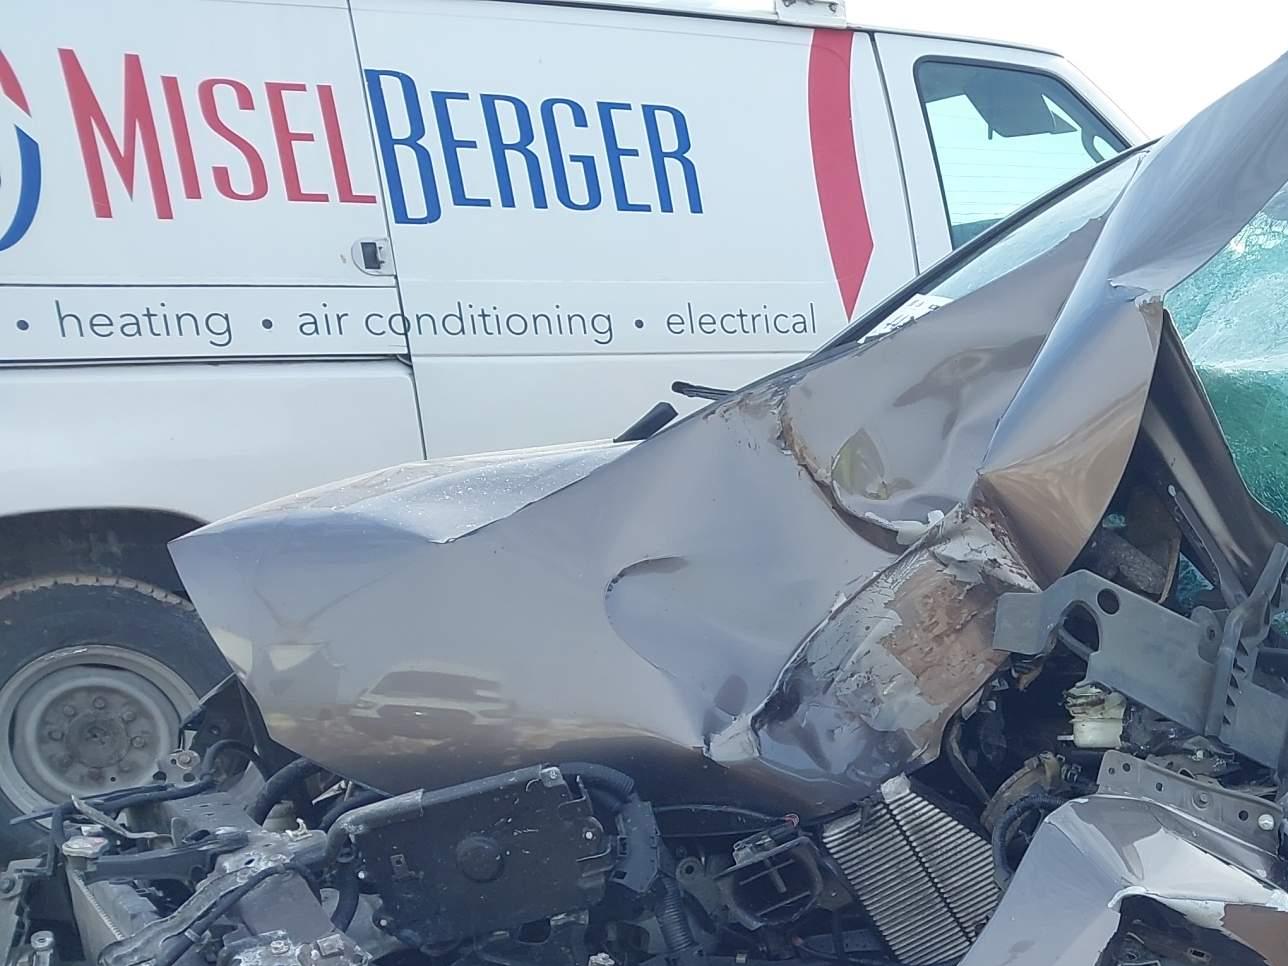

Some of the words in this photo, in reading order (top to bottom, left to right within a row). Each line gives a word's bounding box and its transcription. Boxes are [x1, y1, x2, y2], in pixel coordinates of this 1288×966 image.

[54, 300, 233, 347] heating
[298, 302, 348, 336] air
[364, 300, 614, 346] conditioning
[665, 302, 817, 335] electrical
